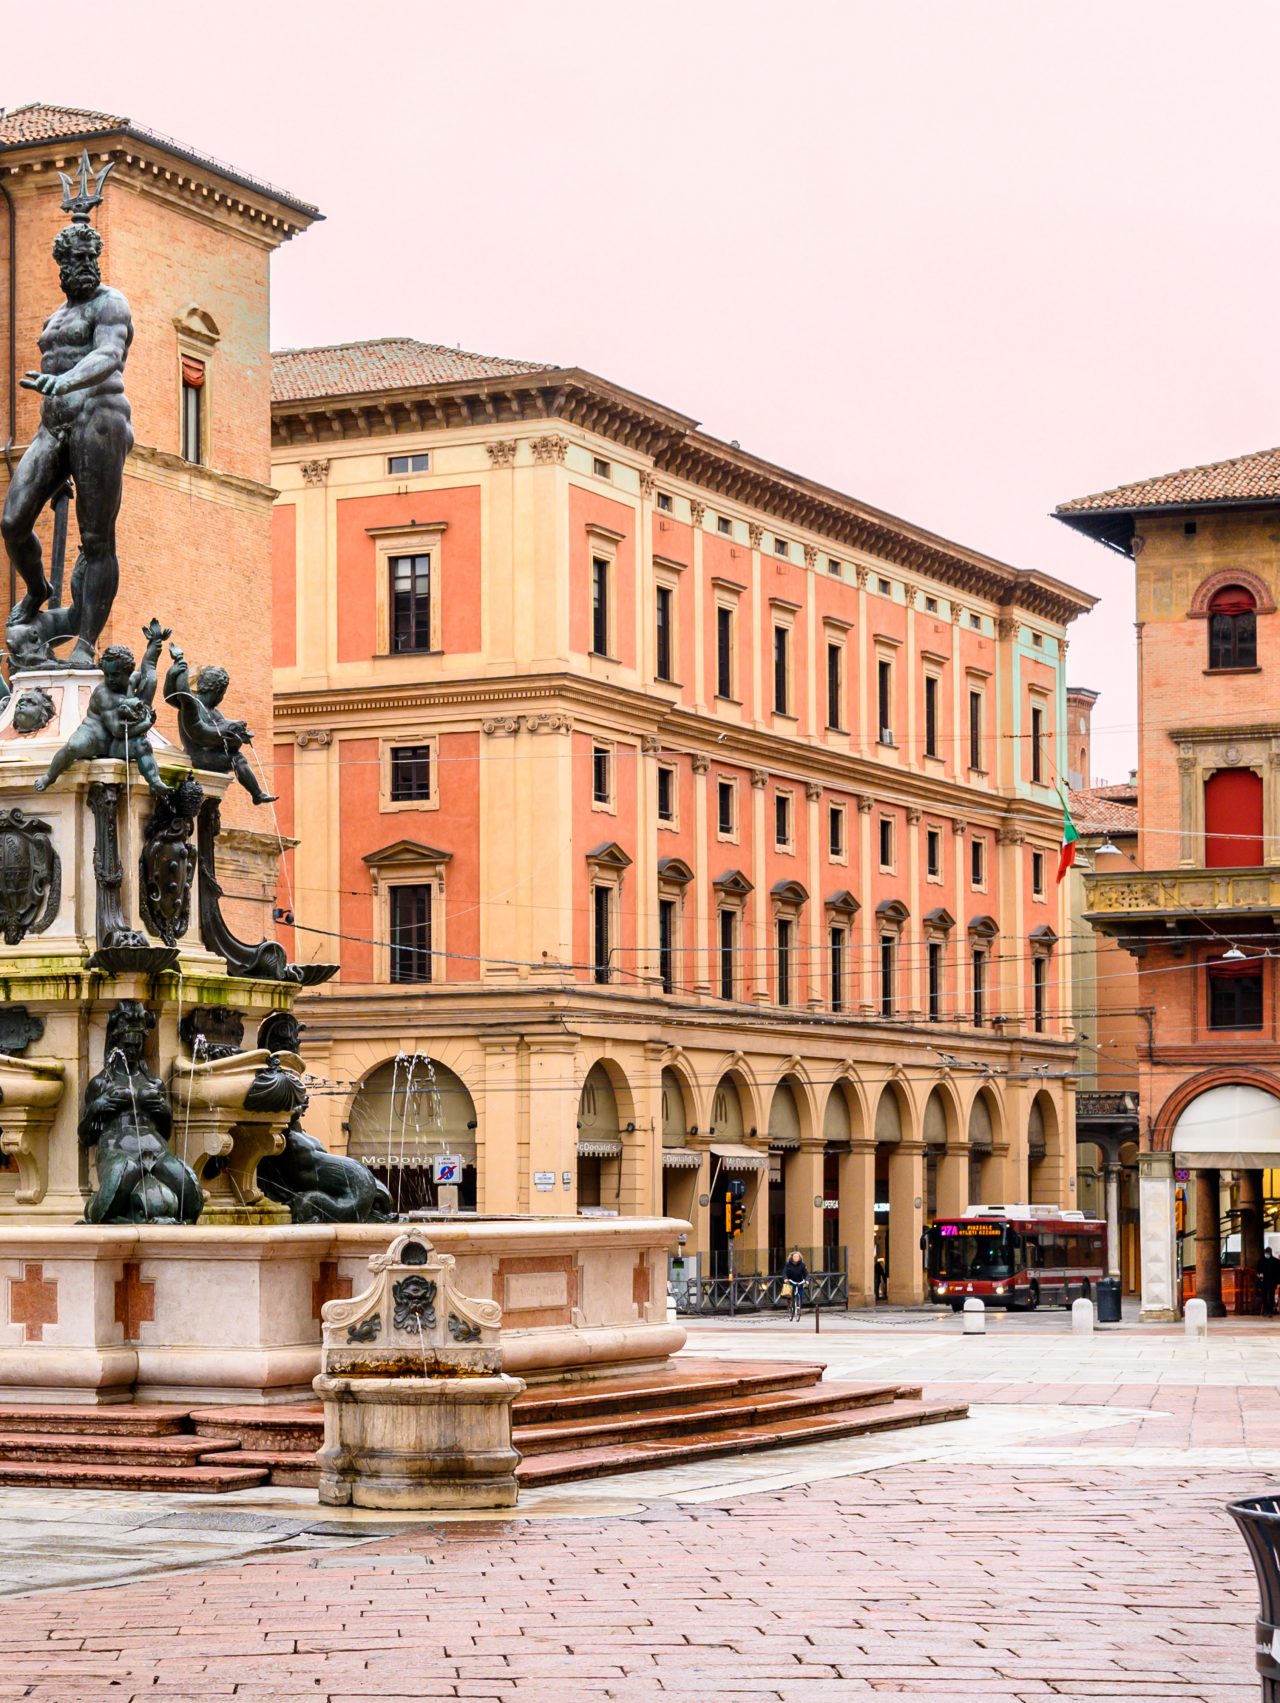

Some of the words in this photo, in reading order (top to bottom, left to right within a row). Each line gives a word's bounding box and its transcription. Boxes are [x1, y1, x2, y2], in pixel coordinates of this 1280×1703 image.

[361, 1155, 466, 1164] McDonas
[663, 1154, 699, 1163] cDonald's
[822, 1200, 839, 1209] UPERGA
[941, 1225, 958, 1236] 27A
